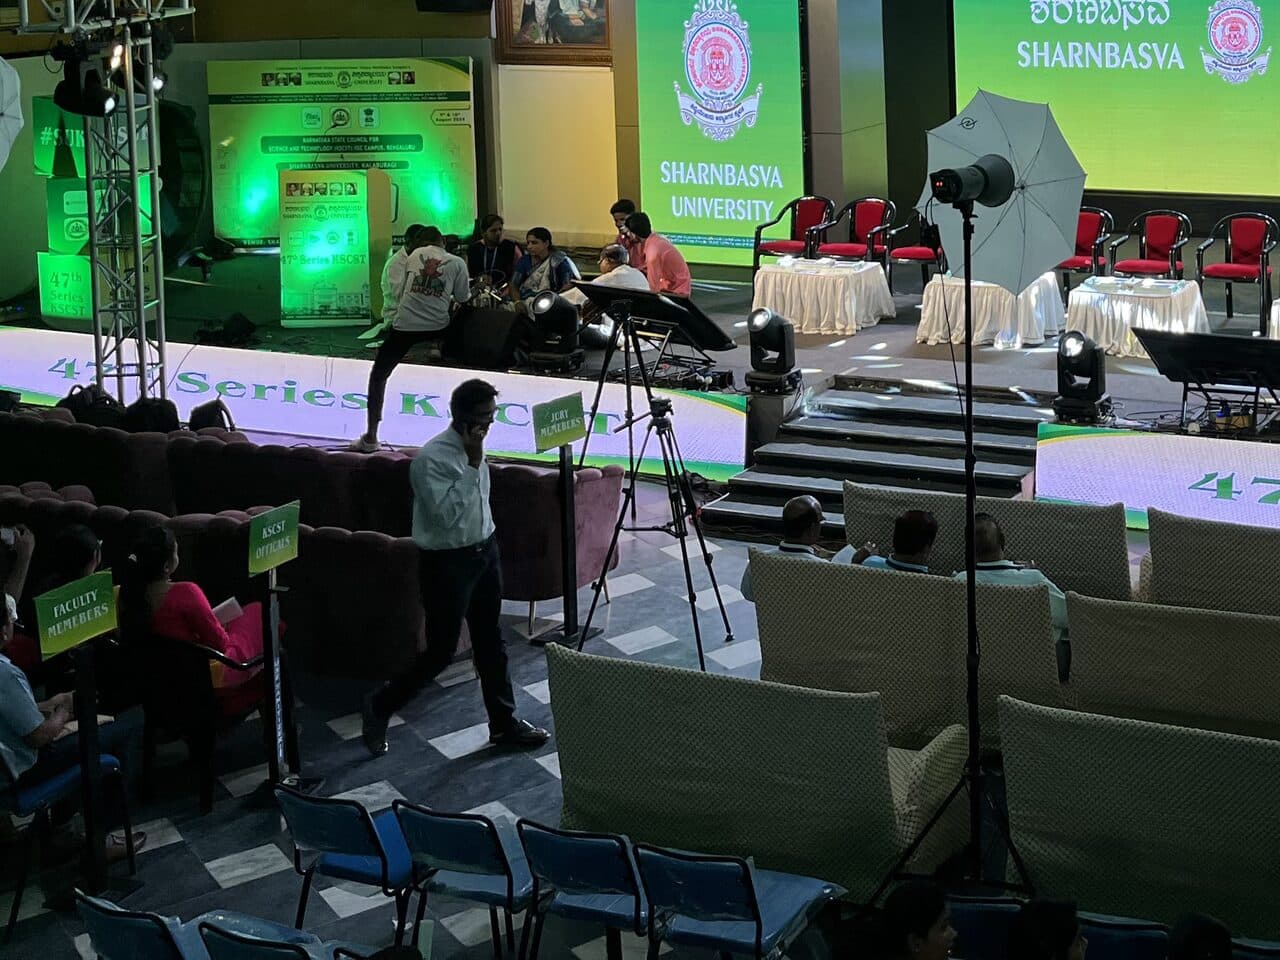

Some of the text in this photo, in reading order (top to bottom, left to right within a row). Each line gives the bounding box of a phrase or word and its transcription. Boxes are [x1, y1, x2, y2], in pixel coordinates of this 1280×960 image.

[1017, 41, 1185, 70] SHARNBASVA
[660, 161, 784, 189] SHARNBASVA
[671, 195, 774, 222] UNIVERSITY
[50, 272, 82, 288] 47th
[50, 290, 83, 303] Series
[262, 520, 286, 539] KSCST
[52, 589, 99, 618] FACULTY
[47, 602, 109, 638] MEMEBERS
